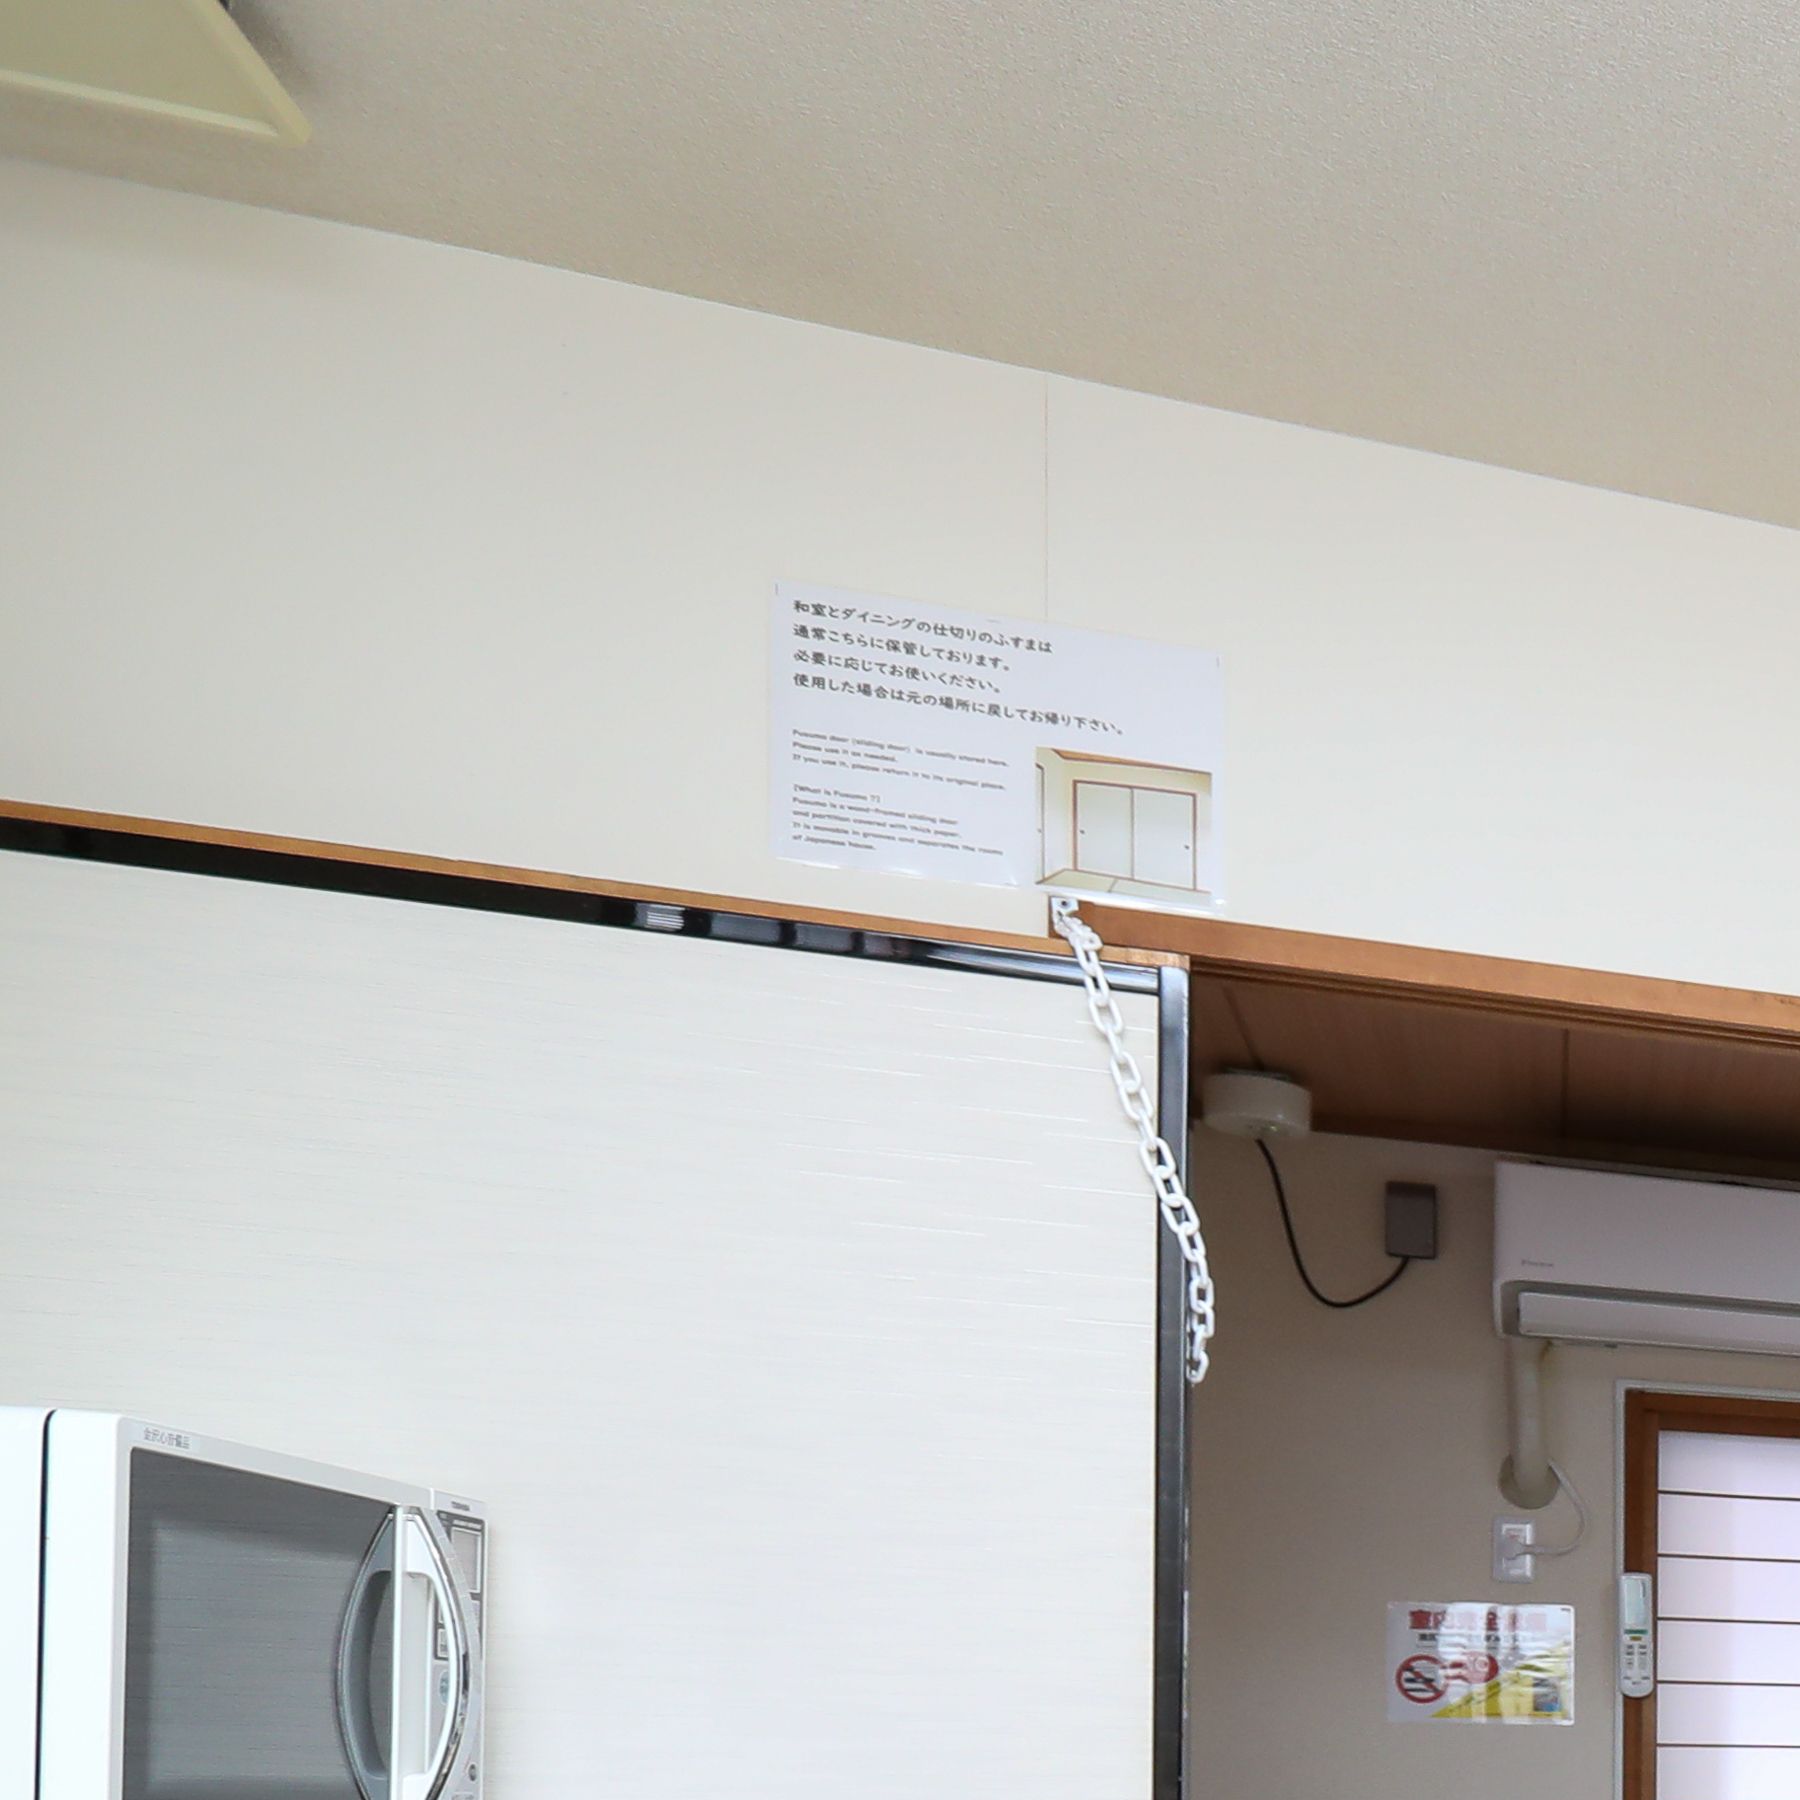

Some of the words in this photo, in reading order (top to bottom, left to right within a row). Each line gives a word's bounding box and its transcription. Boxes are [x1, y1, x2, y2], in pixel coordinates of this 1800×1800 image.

[793, 600, 1053, 653] 和室とダイニングの仕切りのふすまは
[793, 623, 1010, 671] 通常こちらに保管しております。
[793, 649, 1000, 693] 必要に応じてお使いください。
[793, 673, 1123, 735] 使用した場合は元の場所に戻してお帰り下さい。
